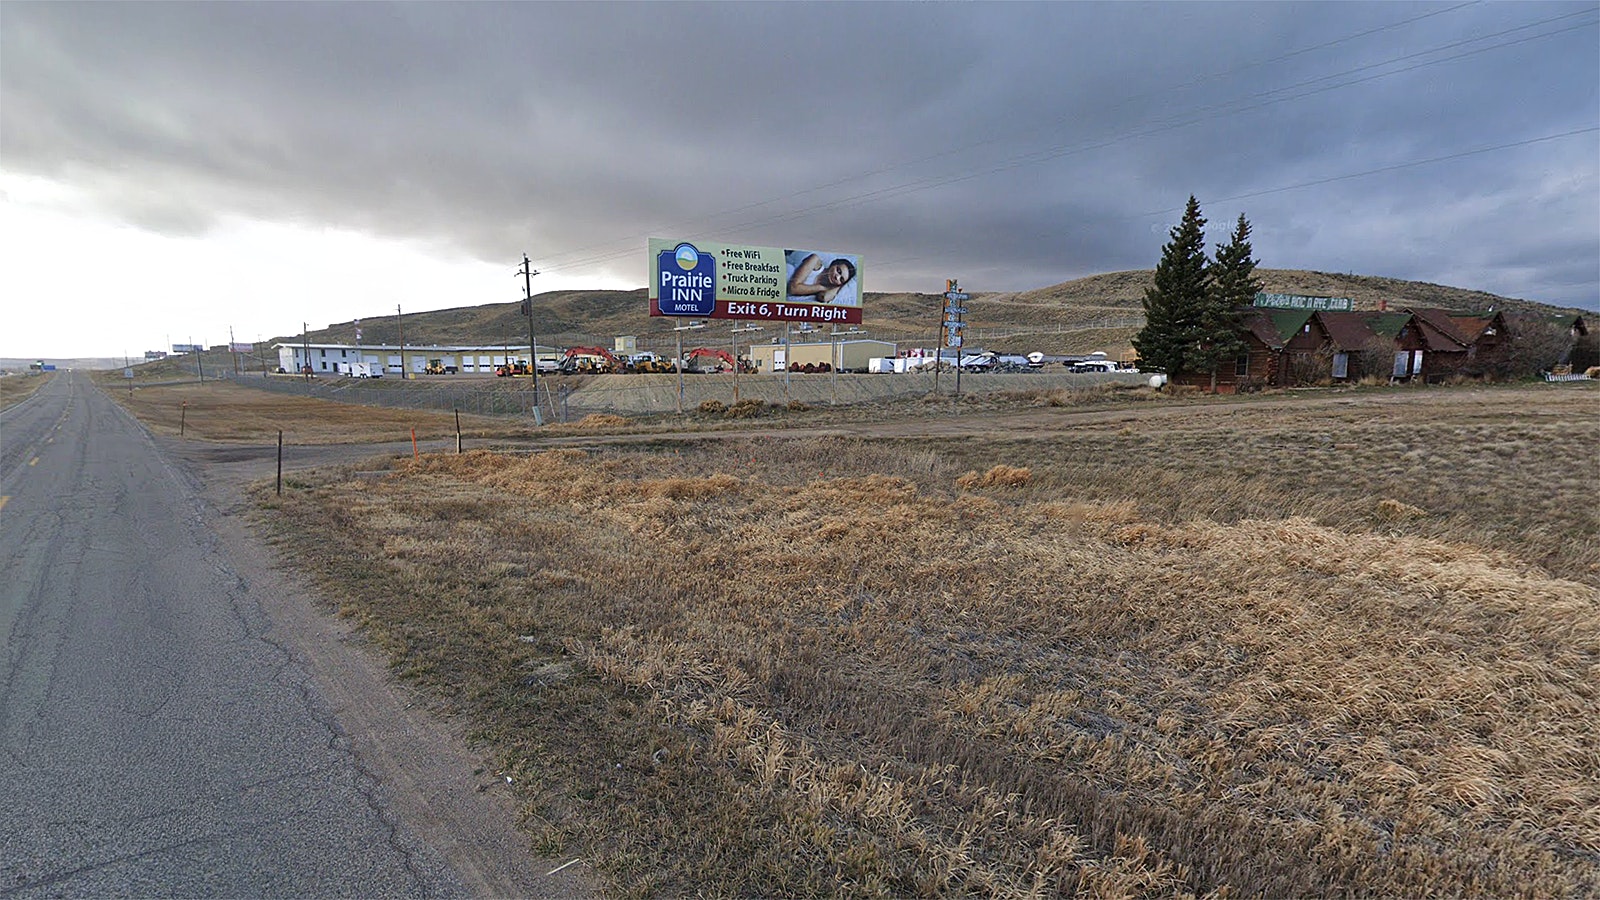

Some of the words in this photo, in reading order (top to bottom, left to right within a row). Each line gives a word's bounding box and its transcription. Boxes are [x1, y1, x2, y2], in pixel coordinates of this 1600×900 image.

[726, 249, 743, 258] Free
[743, 250, 761, 259] WiFi
[727, 261, 743, 270] Free
[744, 262, 780, 273] Breakfast
[661, 271, 713, 288] Prairie
[727, 273, 749, 283] Truck
[749, 274, 778, 287] Parking
[672, 288, 703, 302] INN
[727, 286, 749, 296] Micro
[749, 287, 756, 296] &
[756, 287, 780, 299] Fridge
[674, 303, 699, 312] MOTEL
[727, 302, 757, 315] Exit
[758, 303, 772, 317] 6,
[775, 304, 808, 317] Turn
[811, 306, 847, 320] Right
